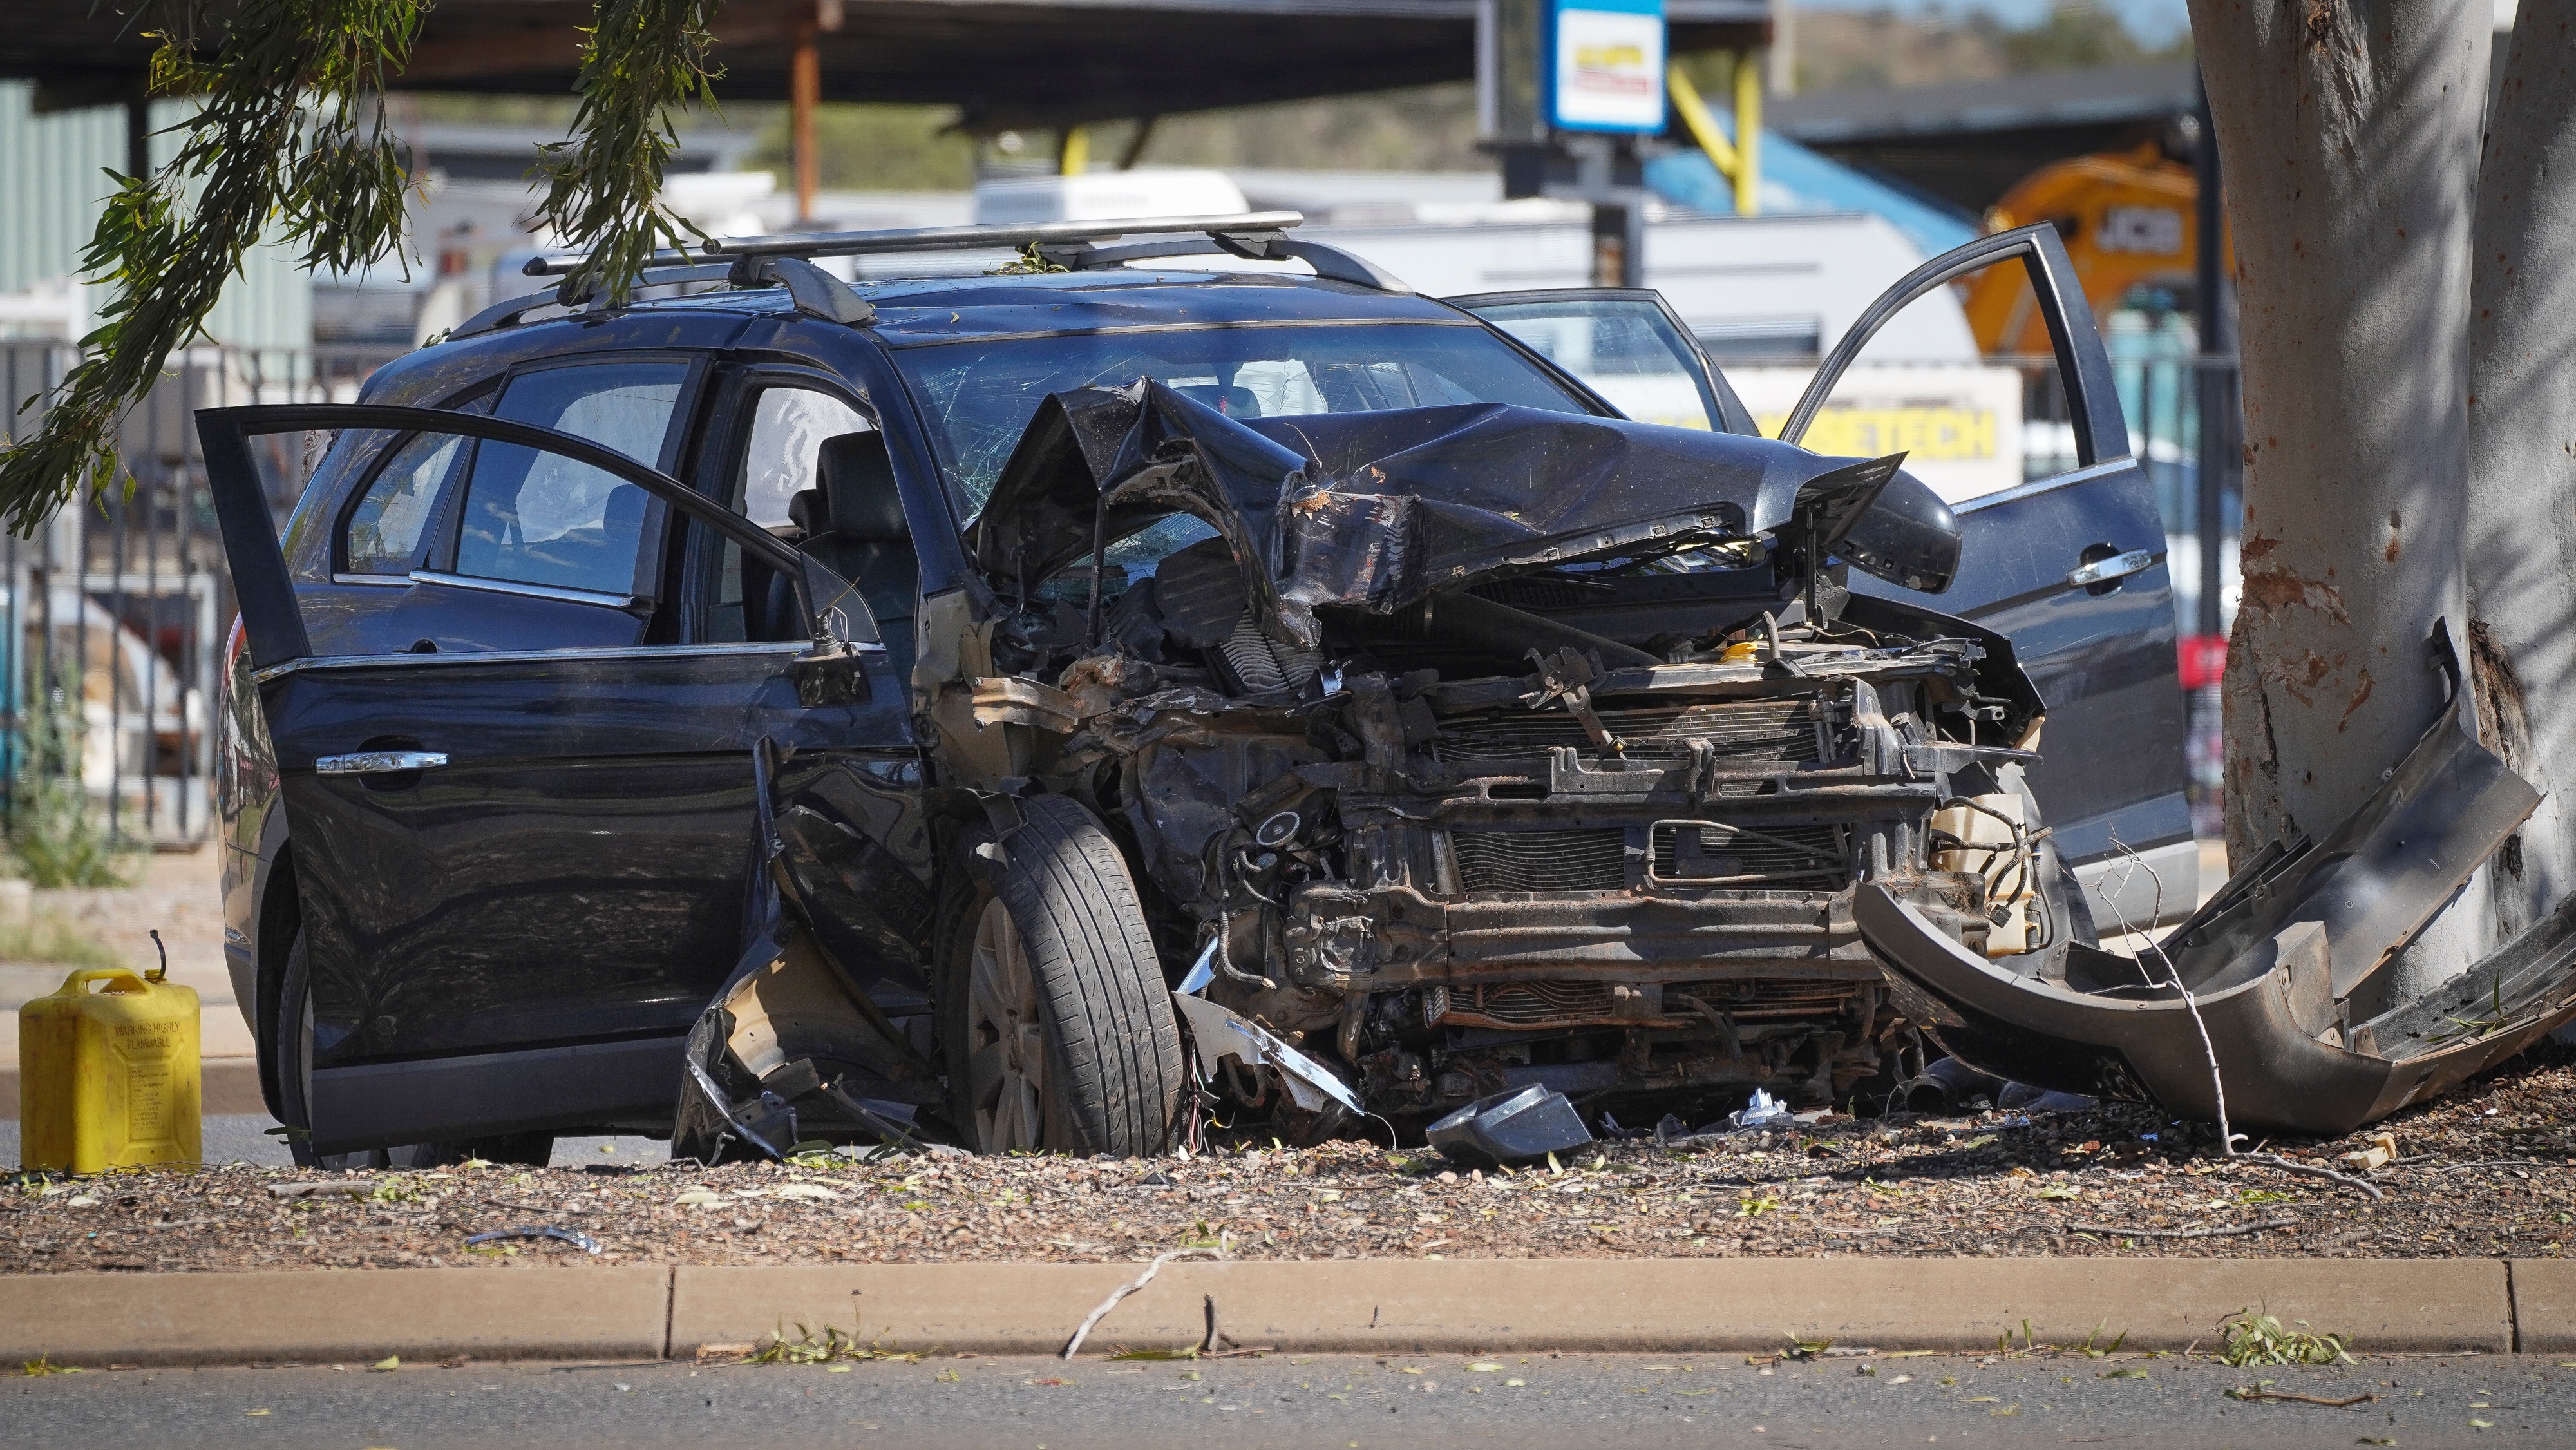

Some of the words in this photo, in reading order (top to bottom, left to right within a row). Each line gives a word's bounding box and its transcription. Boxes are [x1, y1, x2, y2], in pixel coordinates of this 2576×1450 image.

[2096, 206, 2183, 253] JCB
[115, 1023, 151, 1036] WARNING
[153, 1021, 180, 1033] HIGHLY
[127, 1037, 171, 1049] FLAMMABLE
